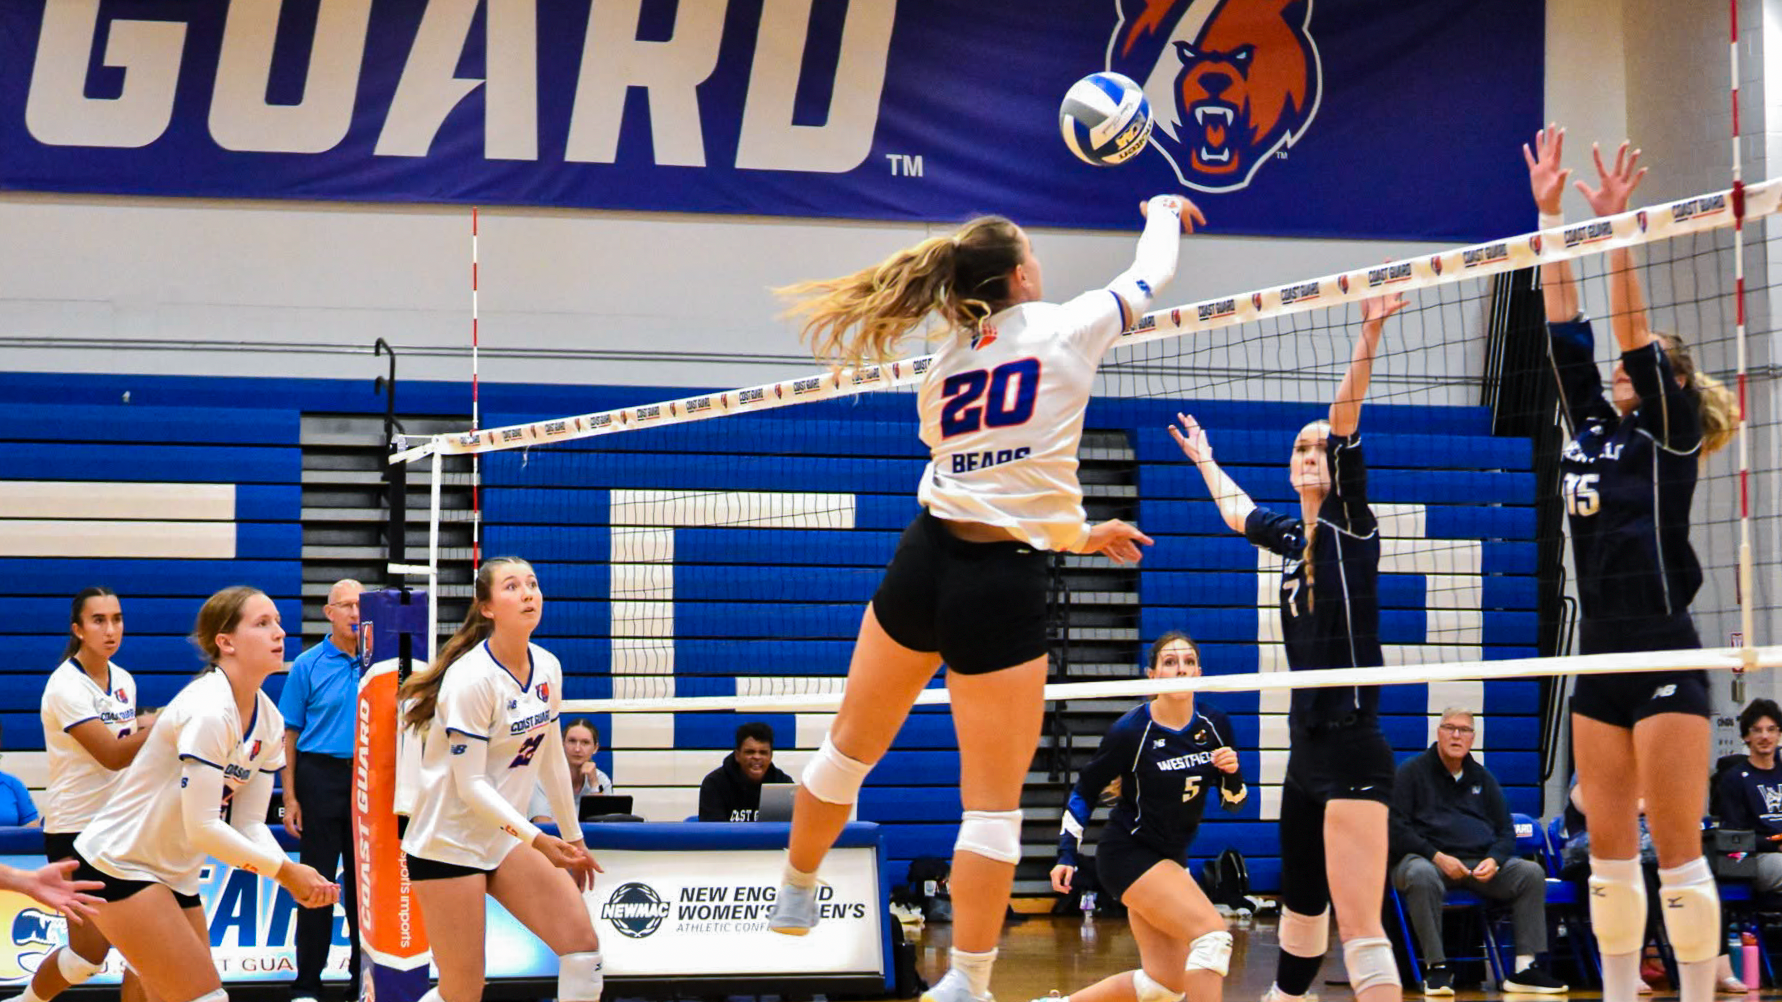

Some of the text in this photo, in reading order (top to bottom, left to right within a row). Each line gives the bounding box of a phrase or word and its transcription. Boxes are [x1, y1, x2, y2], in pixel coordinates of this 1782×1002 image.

[25, 0, 896, 173] GUARD
[886, 154, 923, 177] TM
[1368, 268, 1388, 283] COAST
[940, 357, 1041, 441] 20
[1182, 775, 1203, 803] 5
[356, 698, 372, 931] COAST GUARD
[1515, 823, 1533, 833] ARD
[679, 886, 834, 903] NEW ENGD
[602, 902, 670, 919] NEWMAC
[820, 903, 866, 919] EN'S
[400, 896, 411, 948] imports
[676, 923, 731, 932] ATHLETIC
